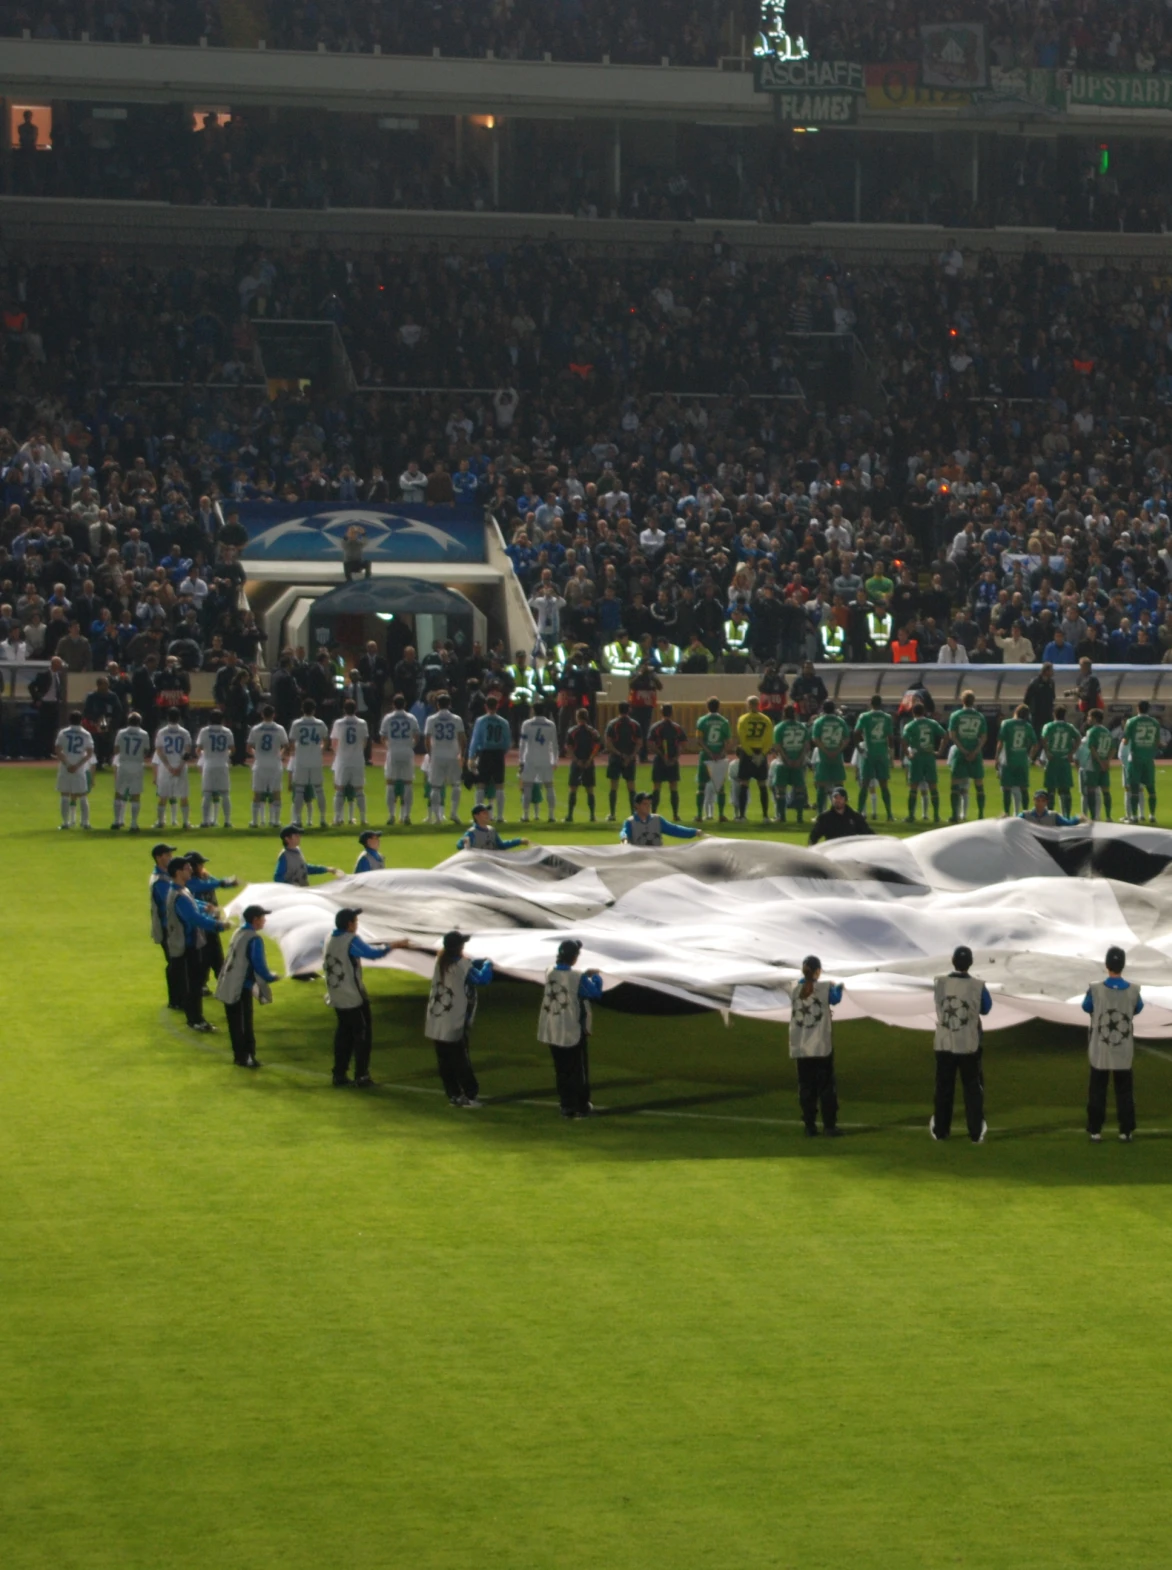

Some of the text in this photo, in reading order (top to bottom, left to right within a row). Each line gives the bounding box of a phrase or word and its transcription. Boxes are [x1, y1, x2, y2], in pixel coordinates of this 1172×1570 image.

[780, 94, 853, 121] FLAMES
[299, 727, 321, 746] 24
[346, 727, 357, 745] 6
[390, 720, 411, 739] 22
[434, 722, 456, 741] 33
[535, 727, 546, 746] 4
[707, 724, 721, 743] 6
[782, 729, 806, 748] 22
[821, 725, 844, 746] 24
[870, 721, 885, 740] 4
[919, 728, 932, 747] 5
[1012, 730, 1026, 748] 8
[1135, 725, 1157, 744] 23
[66, 735, 84, 754] 12
[123, 736, 143, 756] 17
[163, 735, 185, 754] 20
[208, 734, 228, 753] 19
[261, 734, 273, 752] 8
[1052, 731, 1069, 749] 11
